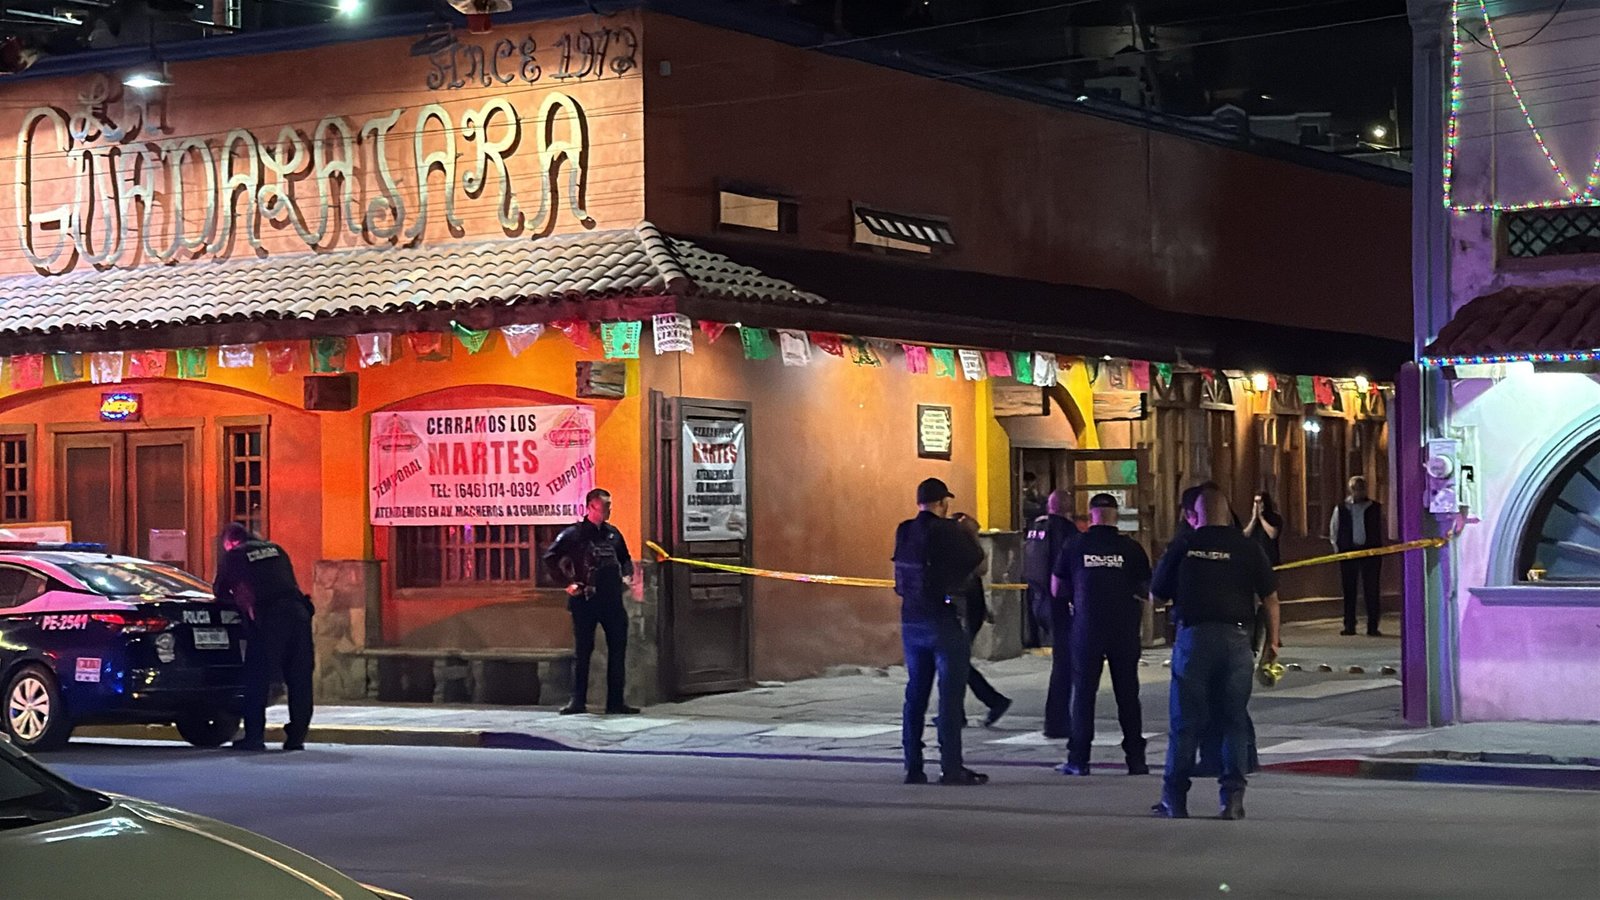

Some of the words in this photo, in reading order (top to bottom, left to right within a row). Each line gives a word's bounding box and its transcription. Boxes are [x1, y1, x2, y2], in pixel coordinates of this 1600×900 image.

[550, 26, 638, 82] 1972
[427, 415, 506, 435] CERRAMOS
[510, 414, 537, 432] LOS
[427, 439, 539, 476] MARTES
[372, 458, 422, 499] TEMPORAL
[546, 454, 594, 495] TEMPORAL
[430, 483, 451, 498] TEL:
[520, 504, 561, 517] CUADRAS
[42, 614, 88, 630] PE-2541
